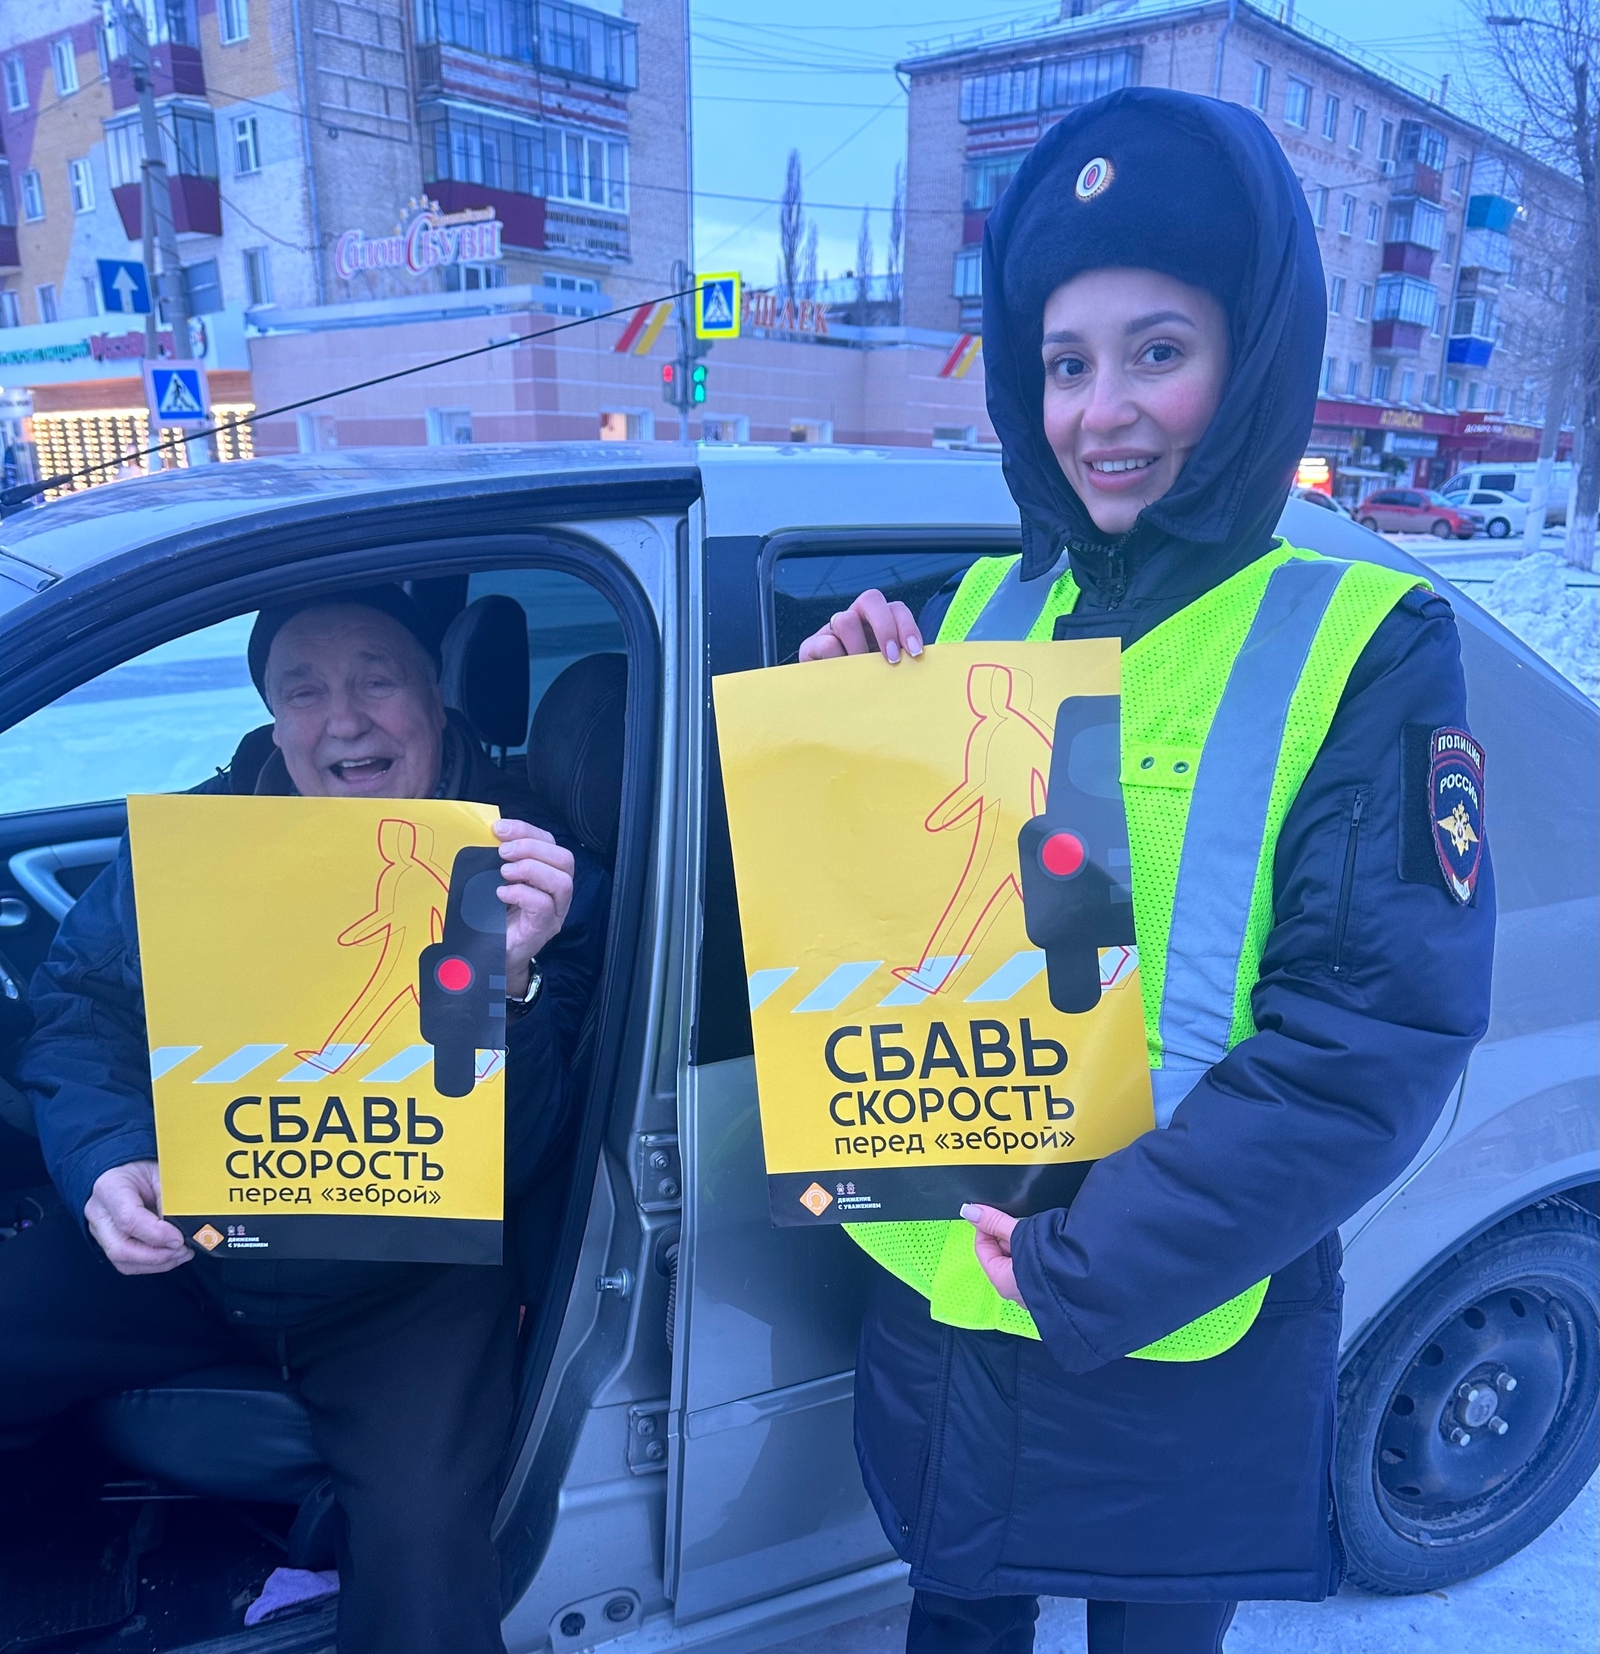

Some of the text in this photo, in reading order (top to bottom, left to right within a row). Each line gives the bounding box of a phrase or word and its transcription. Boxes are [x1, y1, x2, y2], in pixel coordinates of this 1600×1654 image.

[1438, 735, 1481, 769] ПОЛИЦИЯ
[1440, 773, 1478, 810] РОССИЯ
[824, 1018, 1069, 1083] СБАВЬ
[224, 1096, 444, 1145] СБАВЬ
[829, 1085, 1075, 1126] СКОРОСТЬ
[835, 1126, 1076, 1158] перед «зеброй»
[225, 1150, 444, 1181] СКОРОСТЬ
[229, 1183, 442, 1207] перед «зеброй»
[837, 1196, 872, 1204] ДВИЖЕНИЕ
[844, 1202, 882, 1210] УВАЖЕНИЕМ
[1477, 1245, 1576, 1280] NORDMAN
